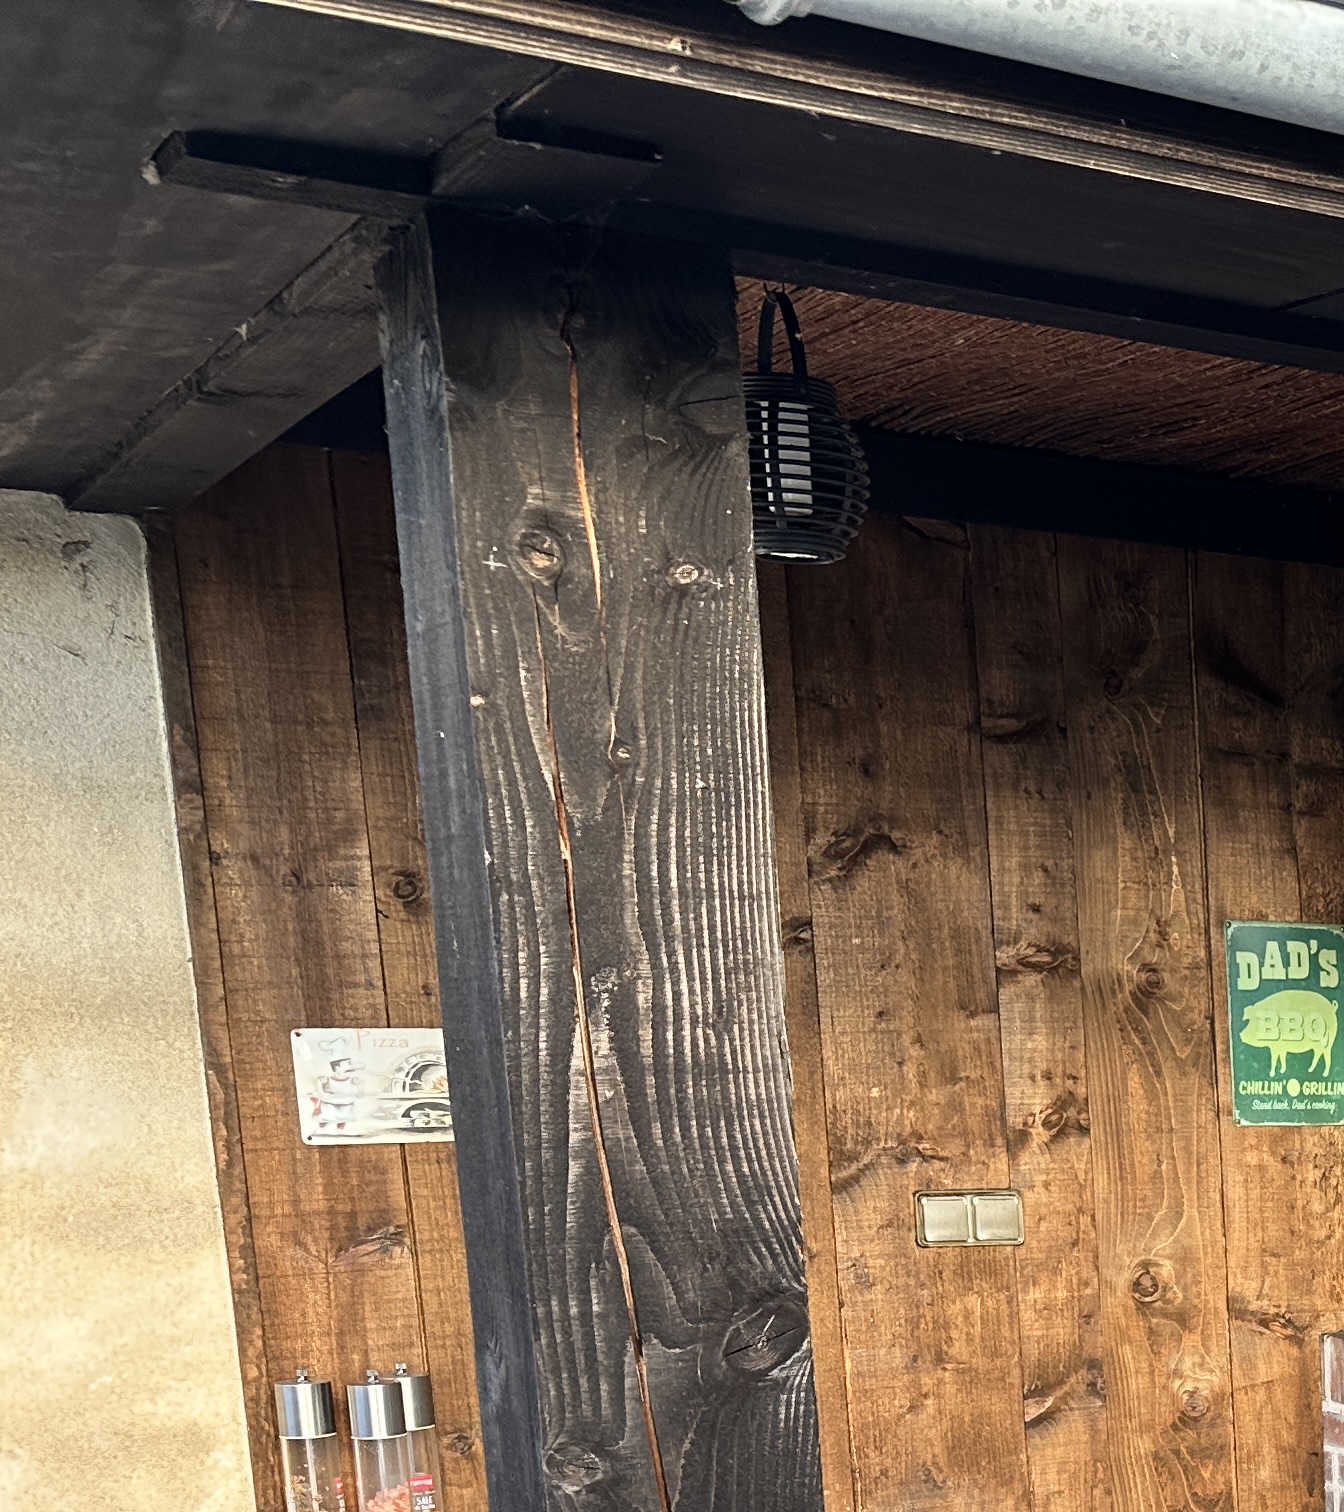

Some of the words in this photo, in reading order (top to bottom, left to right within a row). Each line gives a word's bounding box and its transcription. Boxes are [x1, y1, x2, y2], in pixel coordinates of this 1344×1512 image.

[1235, 939, 1340, 991] DAD'S
[355, 1030, 409, 1050] Pizza
[1255, 1010, 1330, 1049] BBQ
[1239, 1079, 1287, 1096] CHILLIN'
